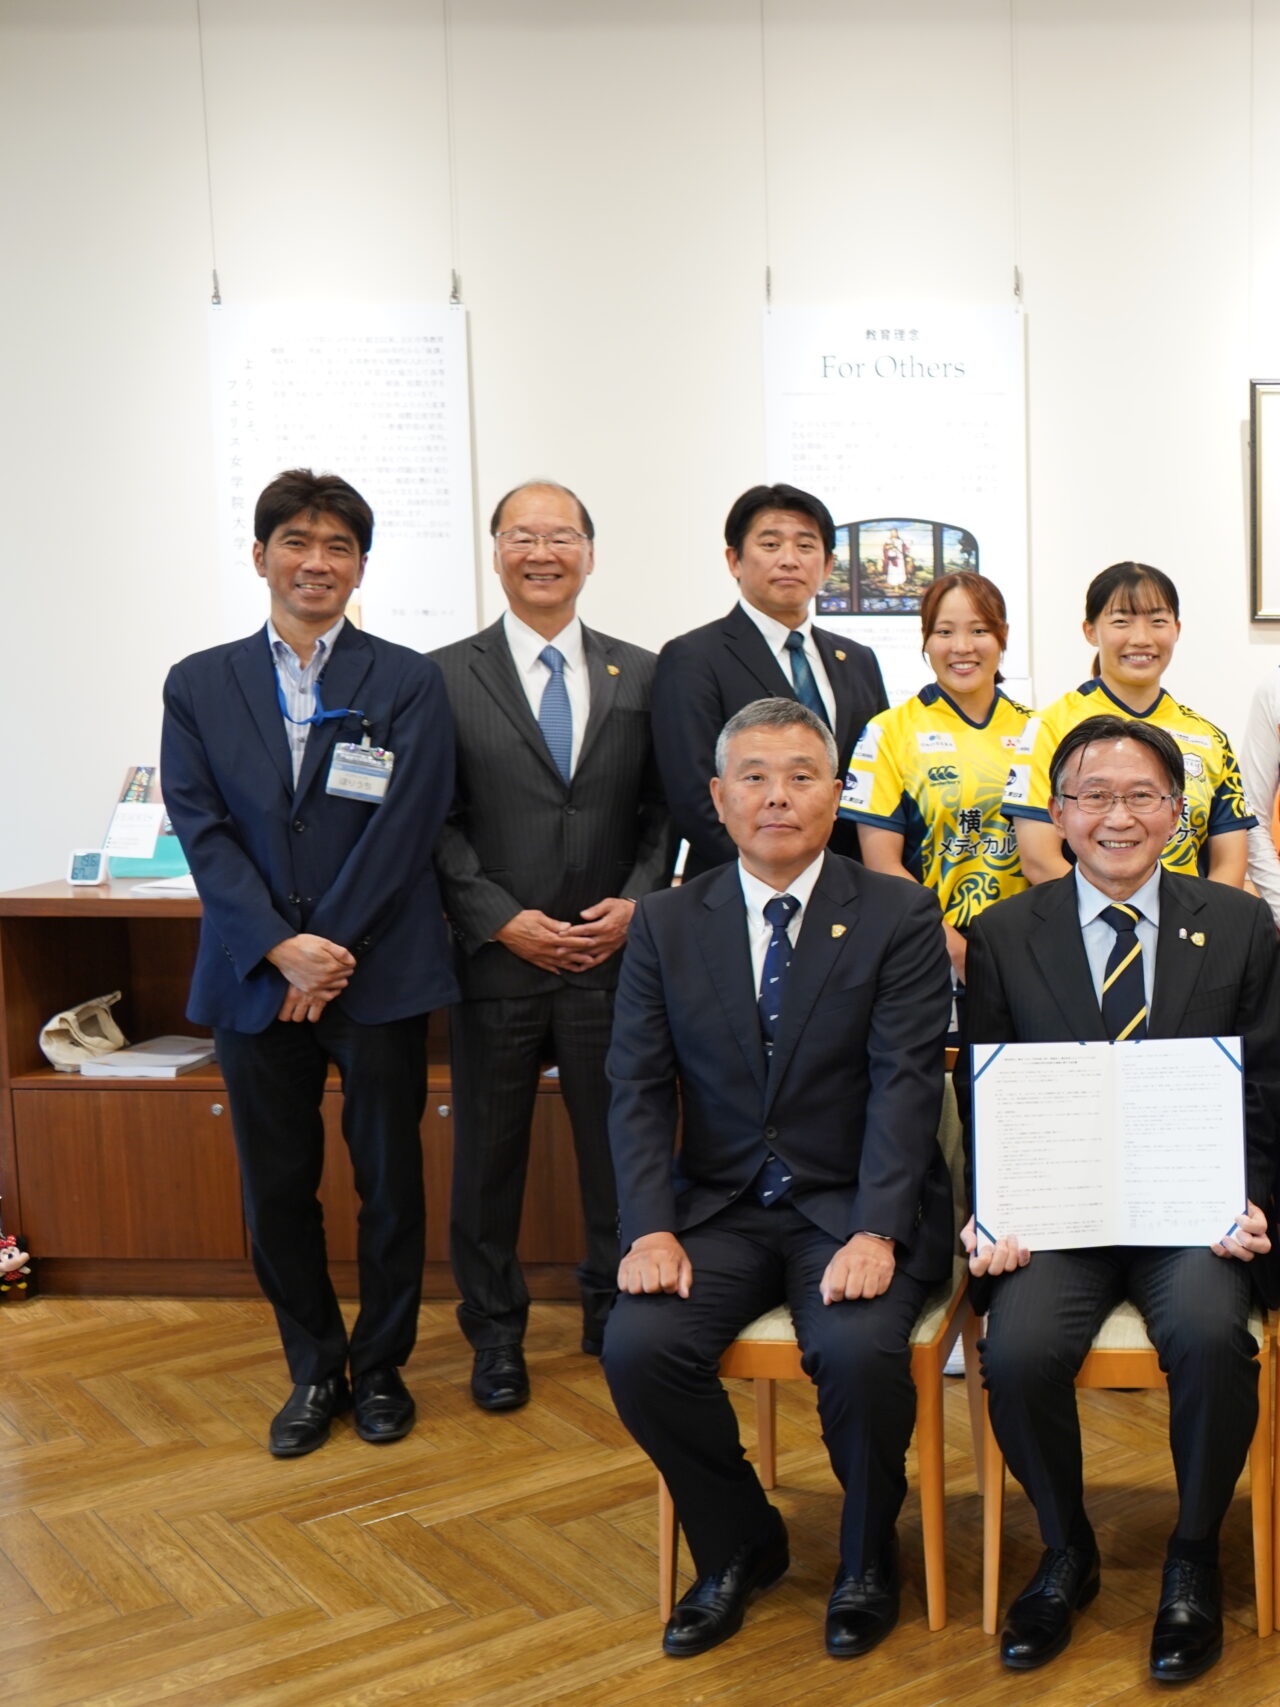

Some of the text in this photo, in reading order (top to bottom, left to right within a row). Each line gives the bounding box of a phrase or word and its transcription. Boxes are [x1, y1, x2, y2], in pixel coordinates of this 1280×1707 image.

[864, 328, 921, 342] 教育理念
[820, 353, 966, 380] For Others
[227, 379, 249, 568] フェリス女学院大学へ
